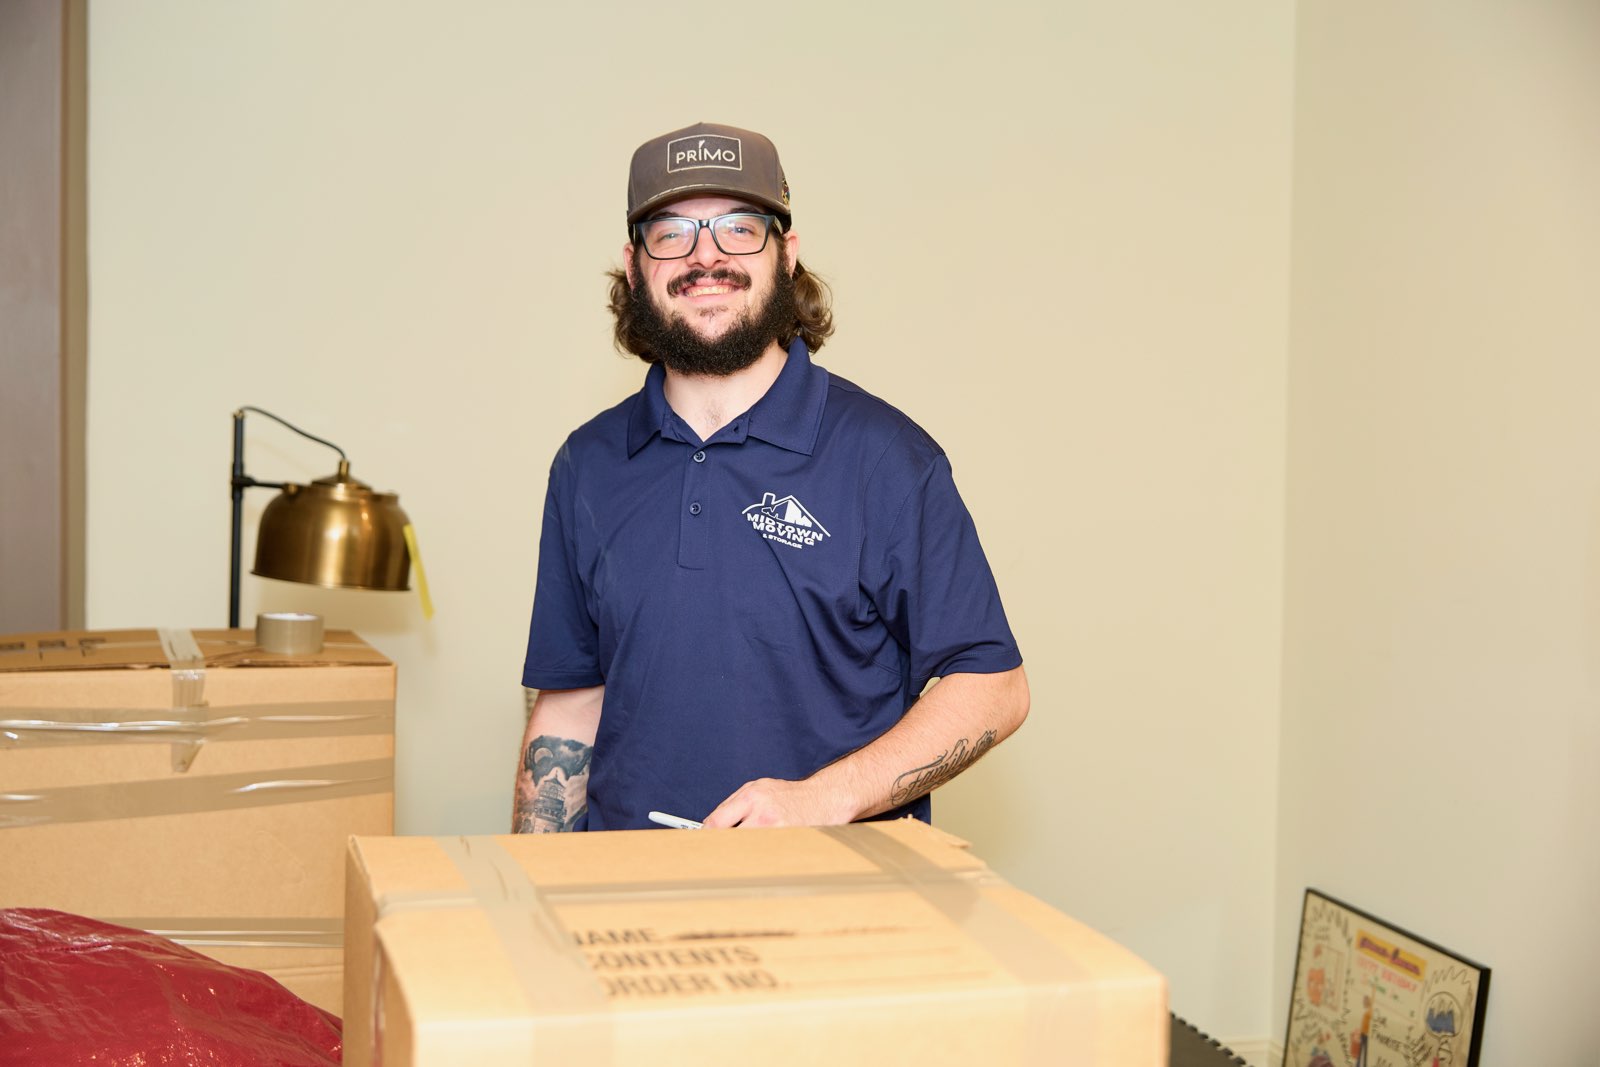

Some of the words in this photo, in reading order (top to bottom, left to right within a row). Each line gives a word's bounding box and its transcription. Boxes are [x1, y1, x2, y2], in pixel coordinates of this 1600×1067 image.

[746, 512, 824, 541] MIDTOWN
[752, 521, 815, 546] MOVING
[768, 534, 803, 549] STORAGE
